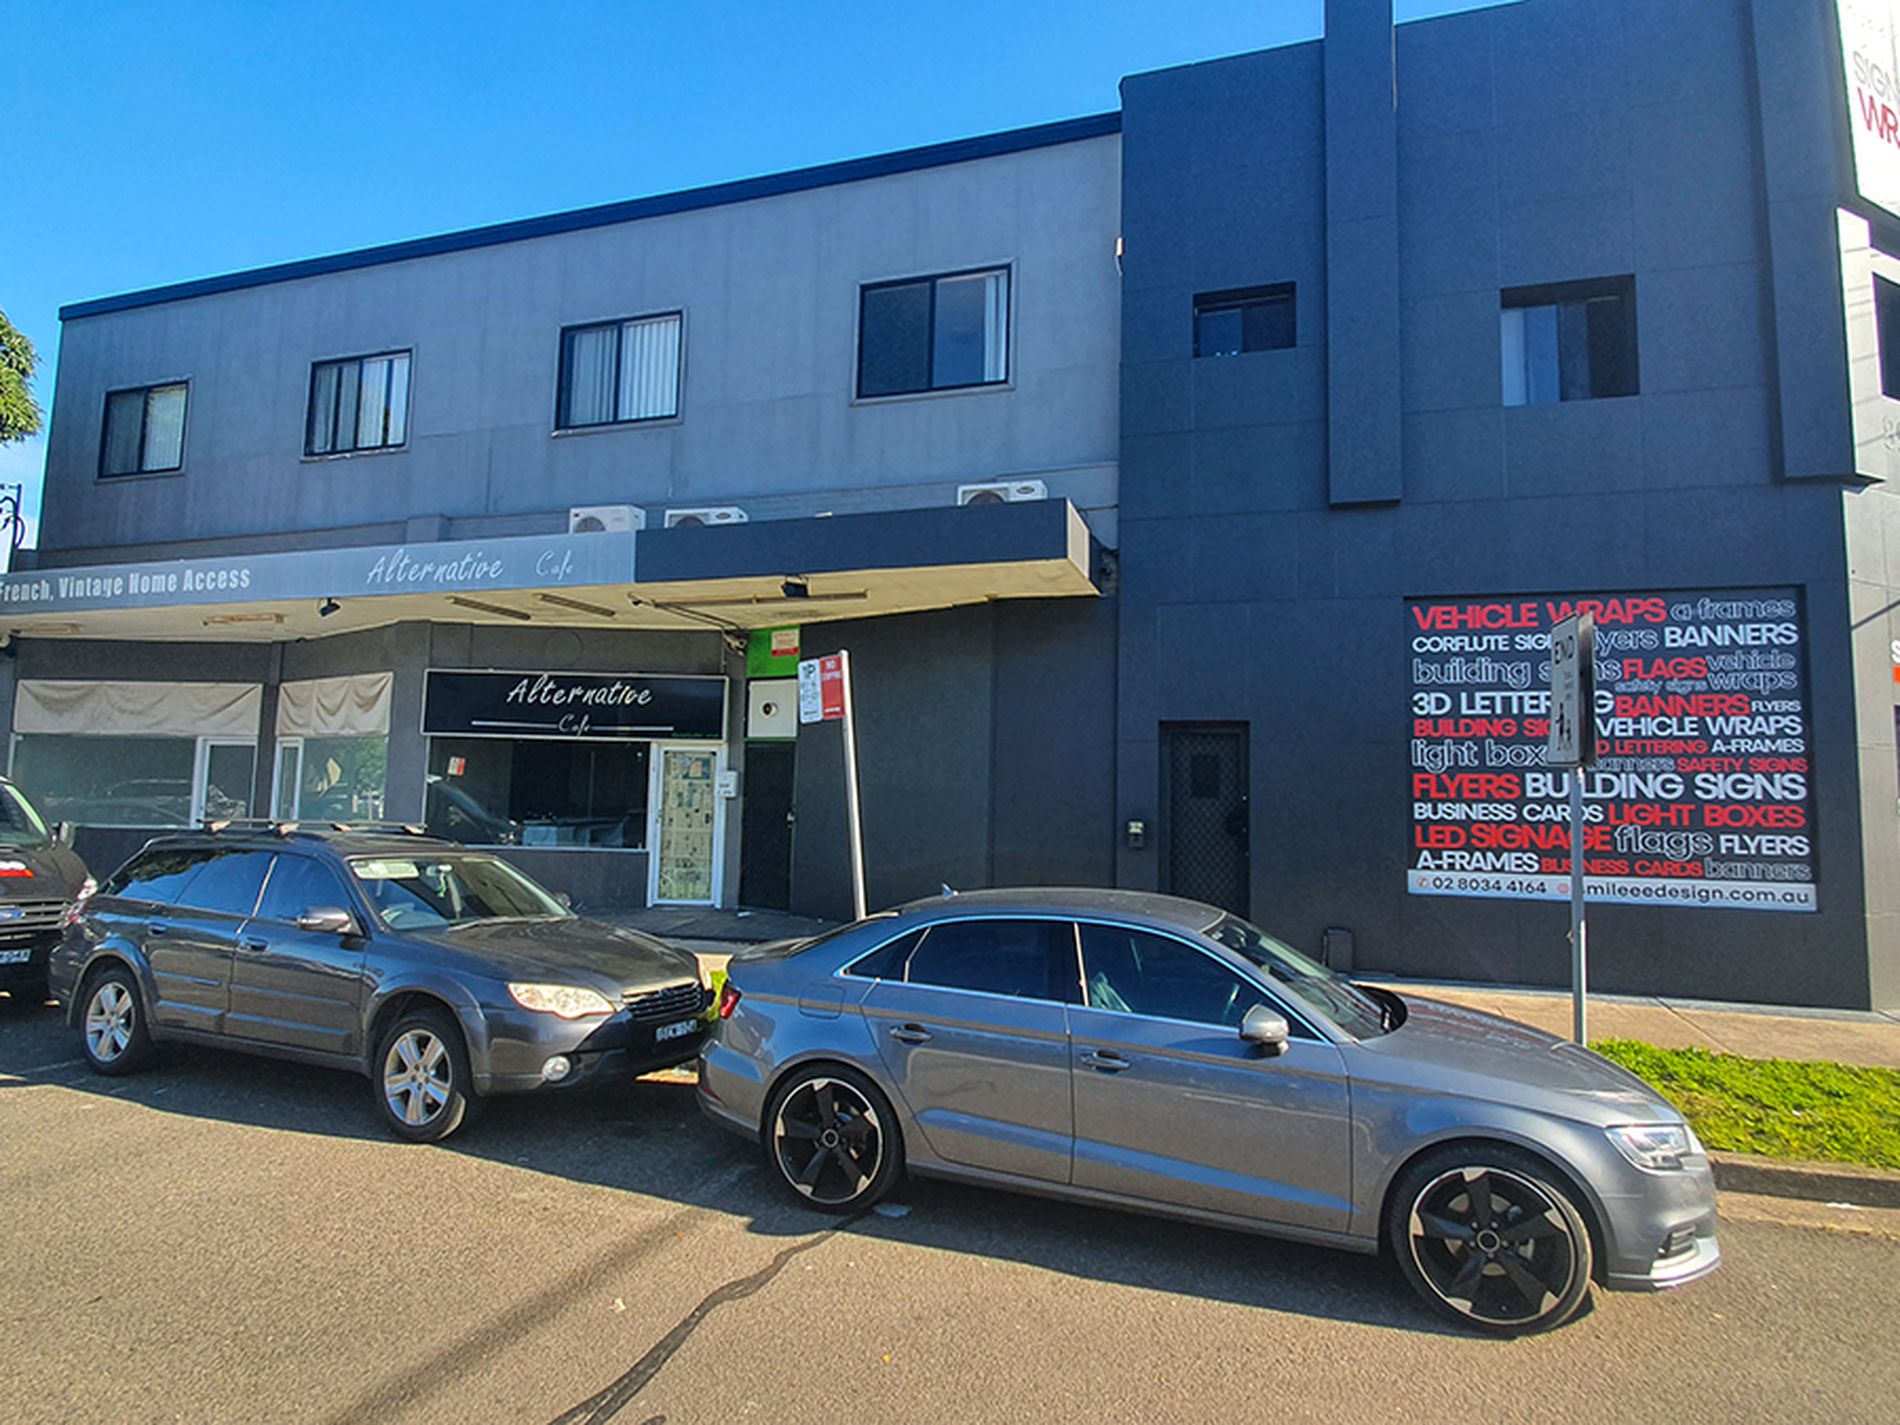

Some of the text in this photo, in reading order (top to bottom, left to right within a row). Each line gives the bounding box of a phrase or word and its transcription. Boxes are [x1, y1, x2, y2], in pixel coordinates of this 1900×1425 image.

[1857, 87, 1900, 150] WR
[128, 573, 177, 594] Home
[183, 569, 250, 591] Access
[366, 548, 503, 584] Alternative
[1412, 603, 1539, 630] VEHICLE
[1546, 598, 1667, 624] WRAPS
[1412, 623, 1799, 657] CORFLUTE SIG yers BANNERS
[1413, 657, 1531, 689] building
[1623, 658, 1708, 679] FLAGS
[1706, 649, 1796, 671] vehicle
[1708, 671, 1798, 695] wraps
[506, 673, 652, 705] Alternative
[1412, 690, 1801, 717] 3D LETTERG BANNERS FLYERS
[1414, 719, 1518, 737] BUILDING
[1595, 717, 1700, 737] VEHICLE
[1705, 715, 1803, 736] WRAPS
[1411, 738, 1804, 774] light box D LETTERING A-FRAMES
[1677, 758, 1745, 772] SAFETY
[1750, 757, 1808, 773] SIGNS
[1413, 772, 1807, 799] FLYERS BULDING SIGNS
[1414, 802, 1517, 820] BUSINESS
[1608, 803, 1696, 826] LIGHT
[1704, 805, 1806, 828] BOXES
[1415, 825, 1467, 848] LED
[1614, 824, 1714, 862] flags
[1719, 835, 1811, 856] FLYERS
[1417, 850, 1811, 881] A-FRAMES BUNESS CARDS banners
[1432, 877, 1810, 904] 02 8034 4164 mileeedesign.com.au
